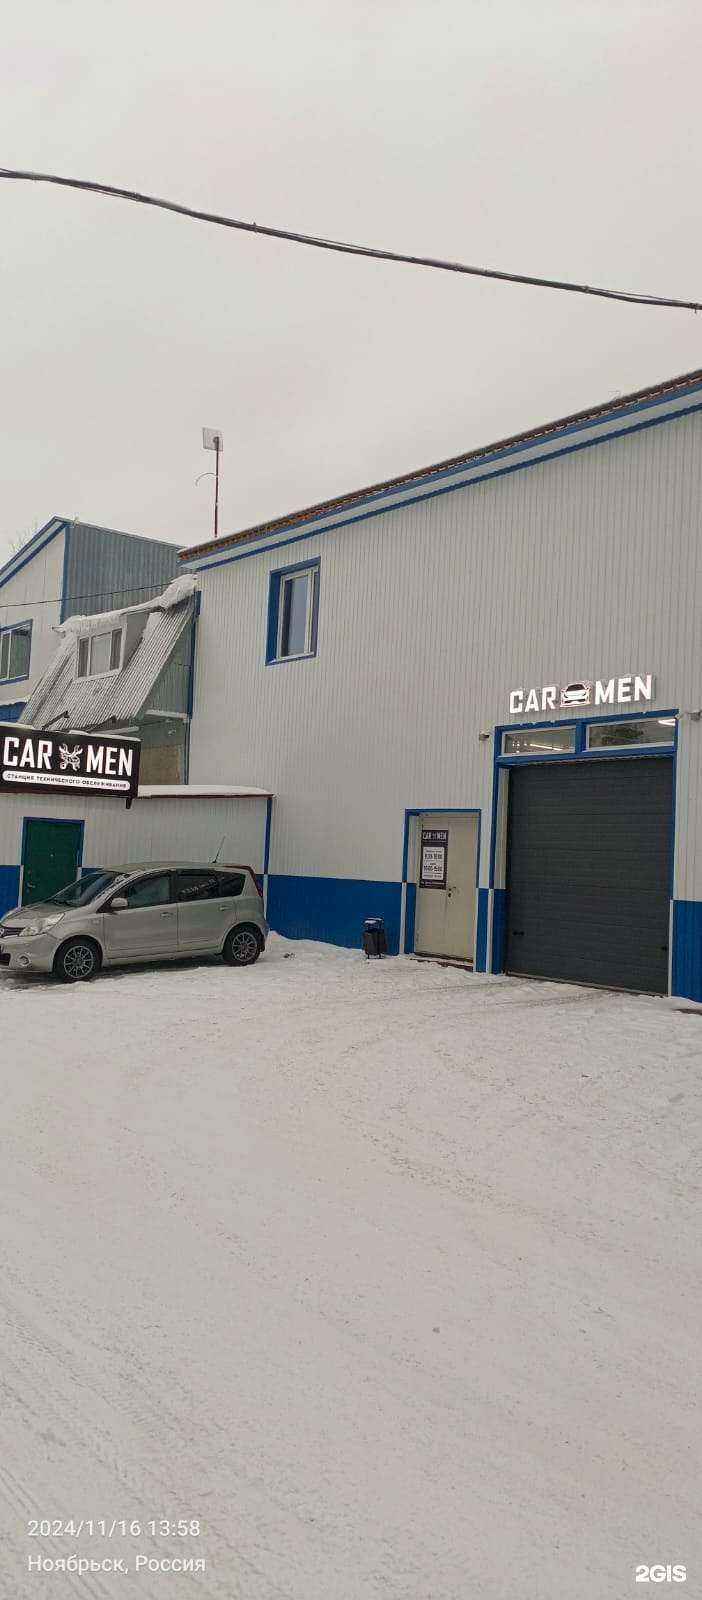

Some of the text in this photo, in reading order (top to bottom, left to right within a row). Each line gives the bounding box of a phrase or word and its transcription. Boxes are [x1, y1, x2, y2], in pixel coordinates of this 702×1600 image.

[509, 674, 653, 714] CAR MEN
[2, 736, 133, 777] CAR MEN
